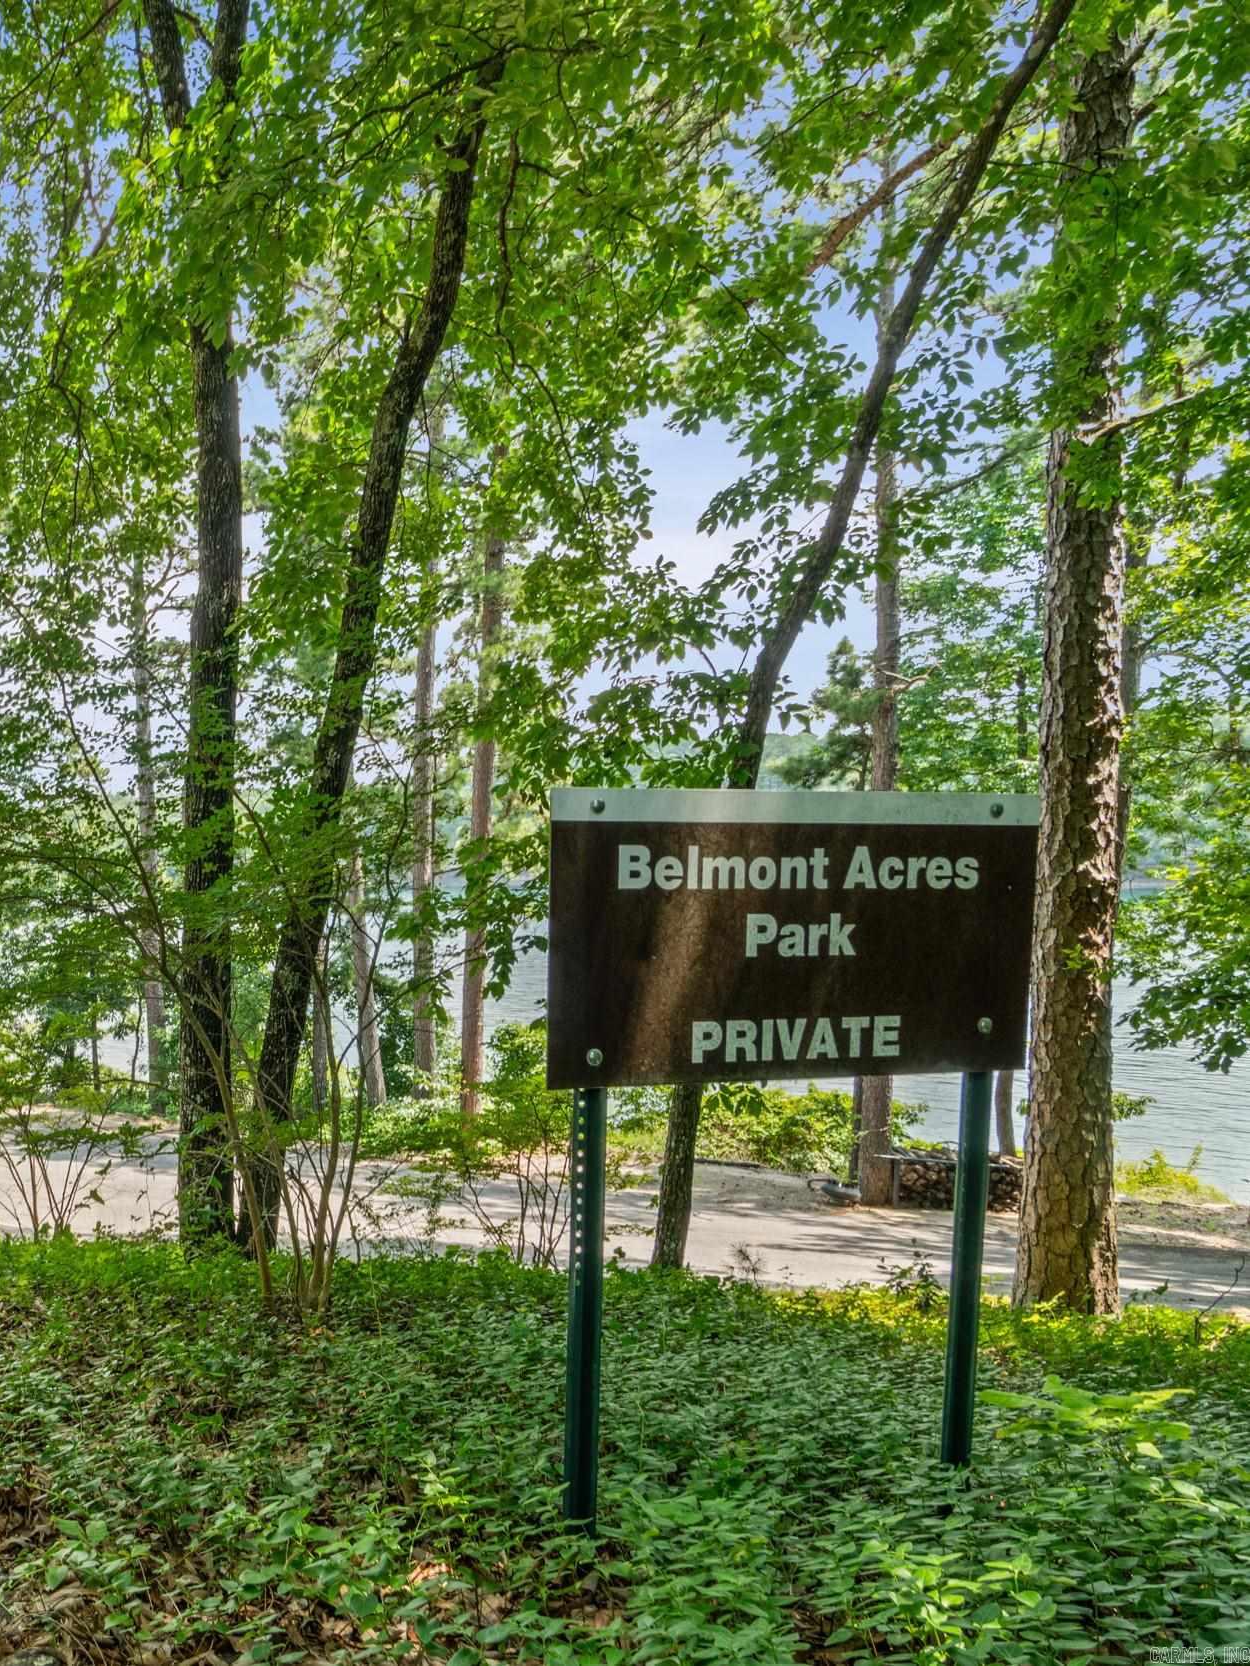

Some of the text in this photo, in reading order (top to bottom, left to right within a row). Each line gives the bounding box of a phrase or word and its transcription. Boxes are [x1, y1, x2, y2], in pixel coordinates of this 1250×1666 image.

[617, 844, 980, 891] Belmont Acres
[745, 912, 856, 958] Park
[691, 1015, 901, 1064] PRIVATE
